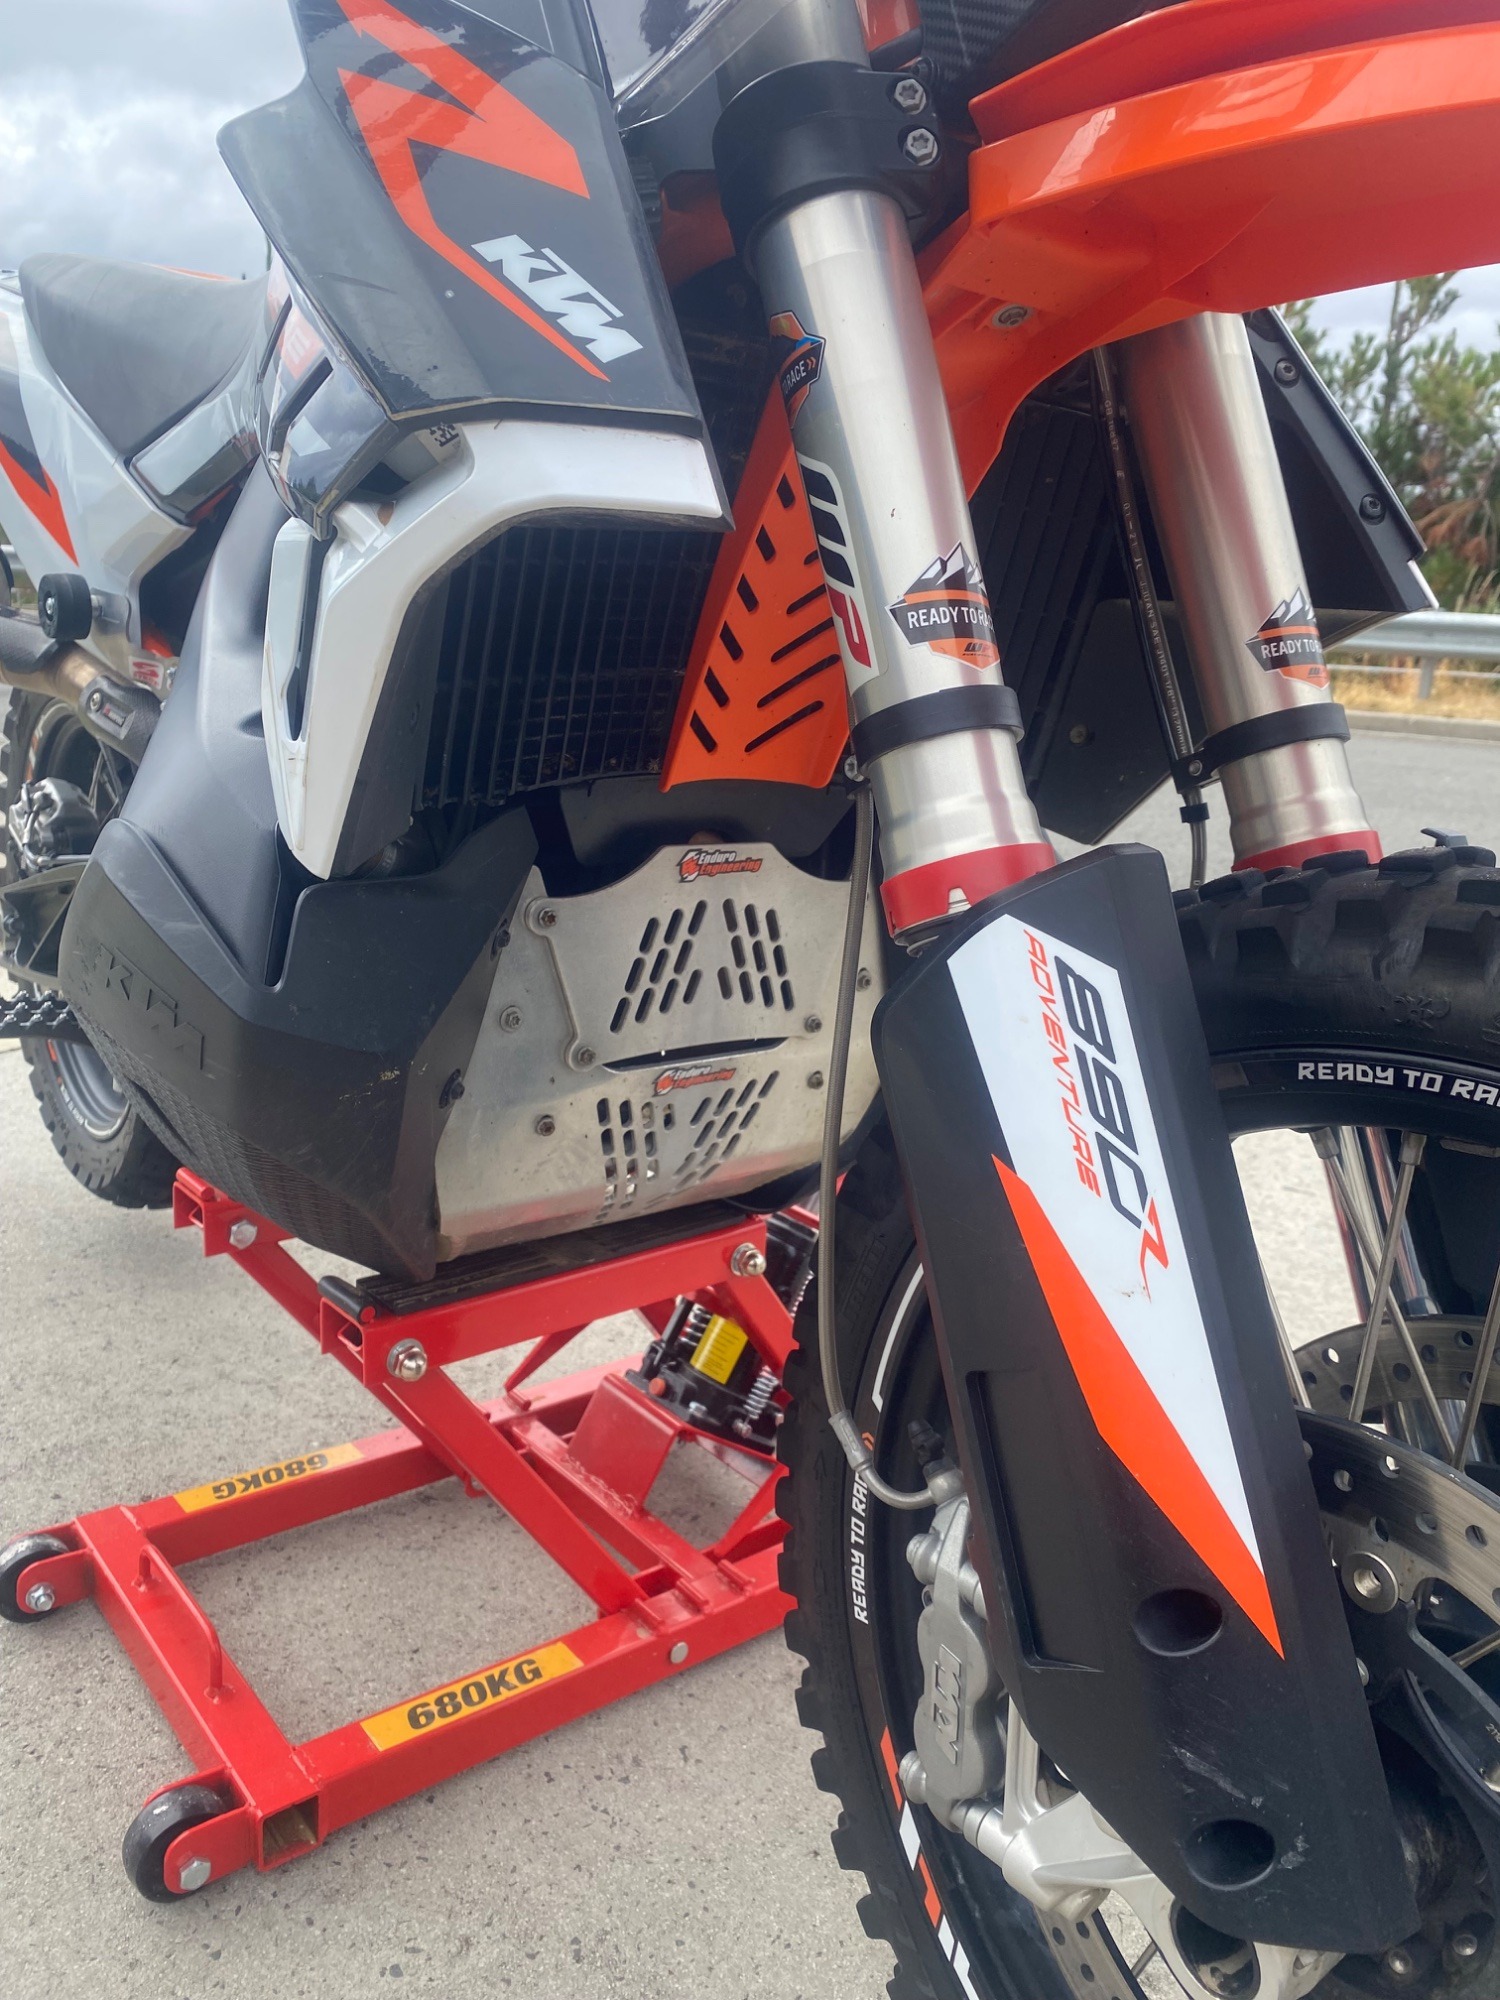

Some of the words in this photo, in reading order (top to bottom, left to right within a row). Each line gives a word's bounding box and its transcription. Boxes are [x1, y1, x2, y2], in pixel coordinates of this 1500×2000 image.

[471, 234, 643, 363] KTM
[786, 360, 807, 388] RACE
[907, 606, 957, 629] READY
[960, 606, 978, 626] TO
[978, 611, 996, 631] RAC
[1261, 639, 1302, 659] READY
[1304, 639, 1316, 653] TO
[698, 851, 736, 864] Enduro
[699, 860, 762, 876] Engineering
[96, 943, 205, 1070] KTM
[1023, 929, 1102, 1198] ADVENTURE
[1298, 1062, 1394, 1086] READY
[1403, 1069, 1443, 1093] TO
[1450, 1078, 1500, 1108] RA
[212, 1453, 329, 1500] 680KG
[850, 1516, 866, 1545] TO
[851, 1548, 869, 1625] READY
[407, 1658, 543, 1730] 680KG
[930, 1643, 962, 1765] KTM
